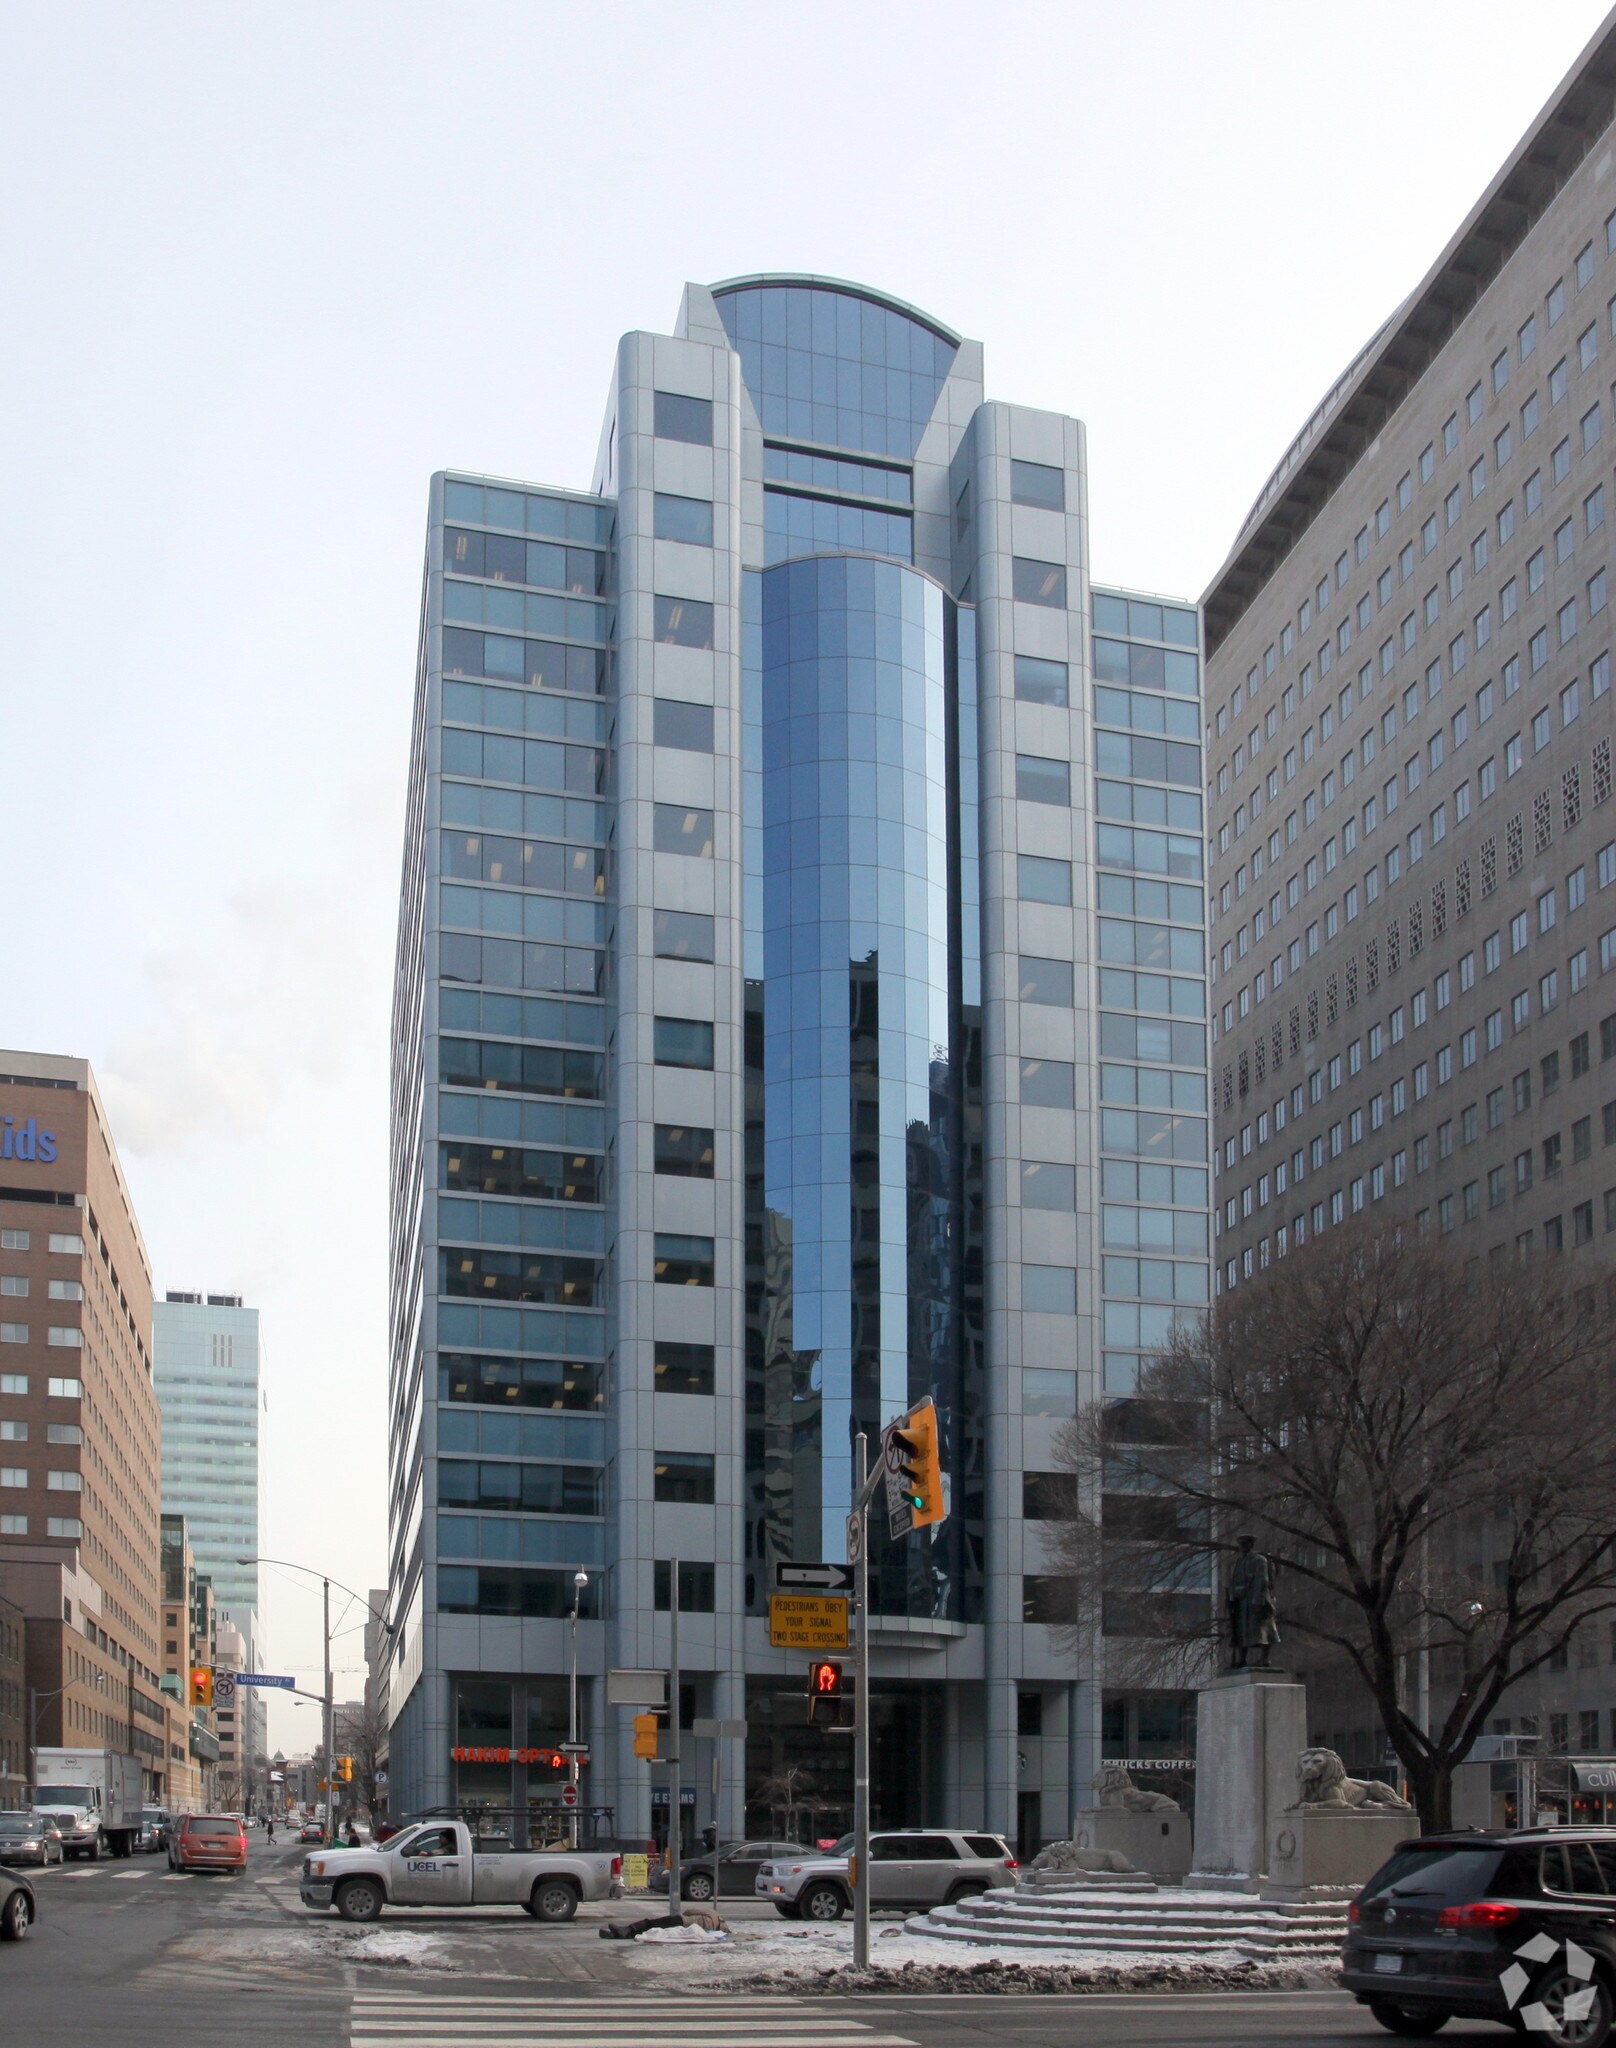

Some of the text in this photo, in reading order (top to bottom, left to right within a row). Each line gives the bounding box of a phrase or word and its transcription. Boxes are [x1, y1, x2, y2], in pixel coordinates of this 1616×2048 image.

[0, 1115, 58, 1163] ids
[775, 1600, 843, 1613] PEDESTRIANS OBEY
[785, 1616, 832, 1628] YOUR SIGNAL
[773, 1631, 845, 1643] TWO STAGE CROSSING
[240, 1674, 282, 1687] University
[454, 1745, 510, 1763] HAKIM
[407, 1862, 441, 1873] UCEL
